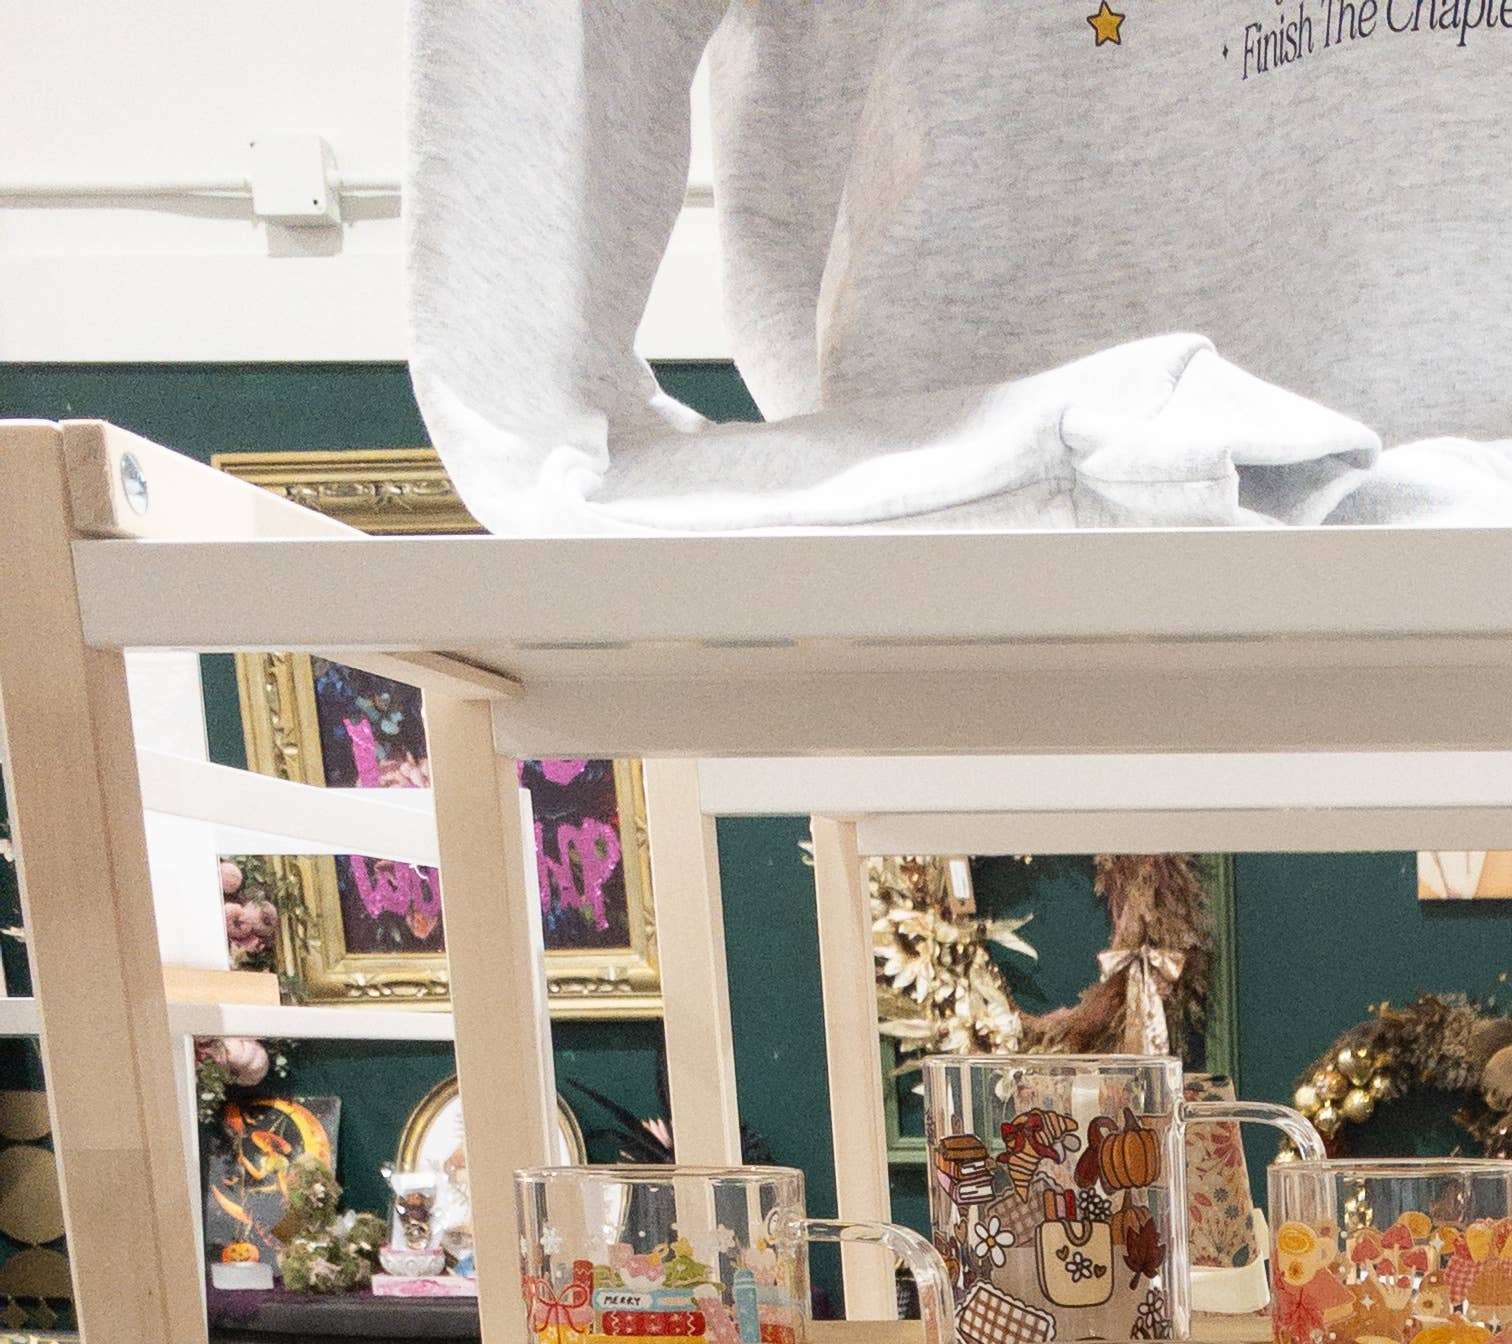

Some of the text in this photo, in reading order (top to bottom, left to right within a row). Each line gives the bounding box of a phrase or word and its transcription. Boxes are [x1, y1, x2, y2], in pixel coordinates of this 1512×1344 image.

[1242, 7, 1314, 80] Finish
[1317, 0, 1377, 47] The
[603, 1295, 641, 1306] MERRY
